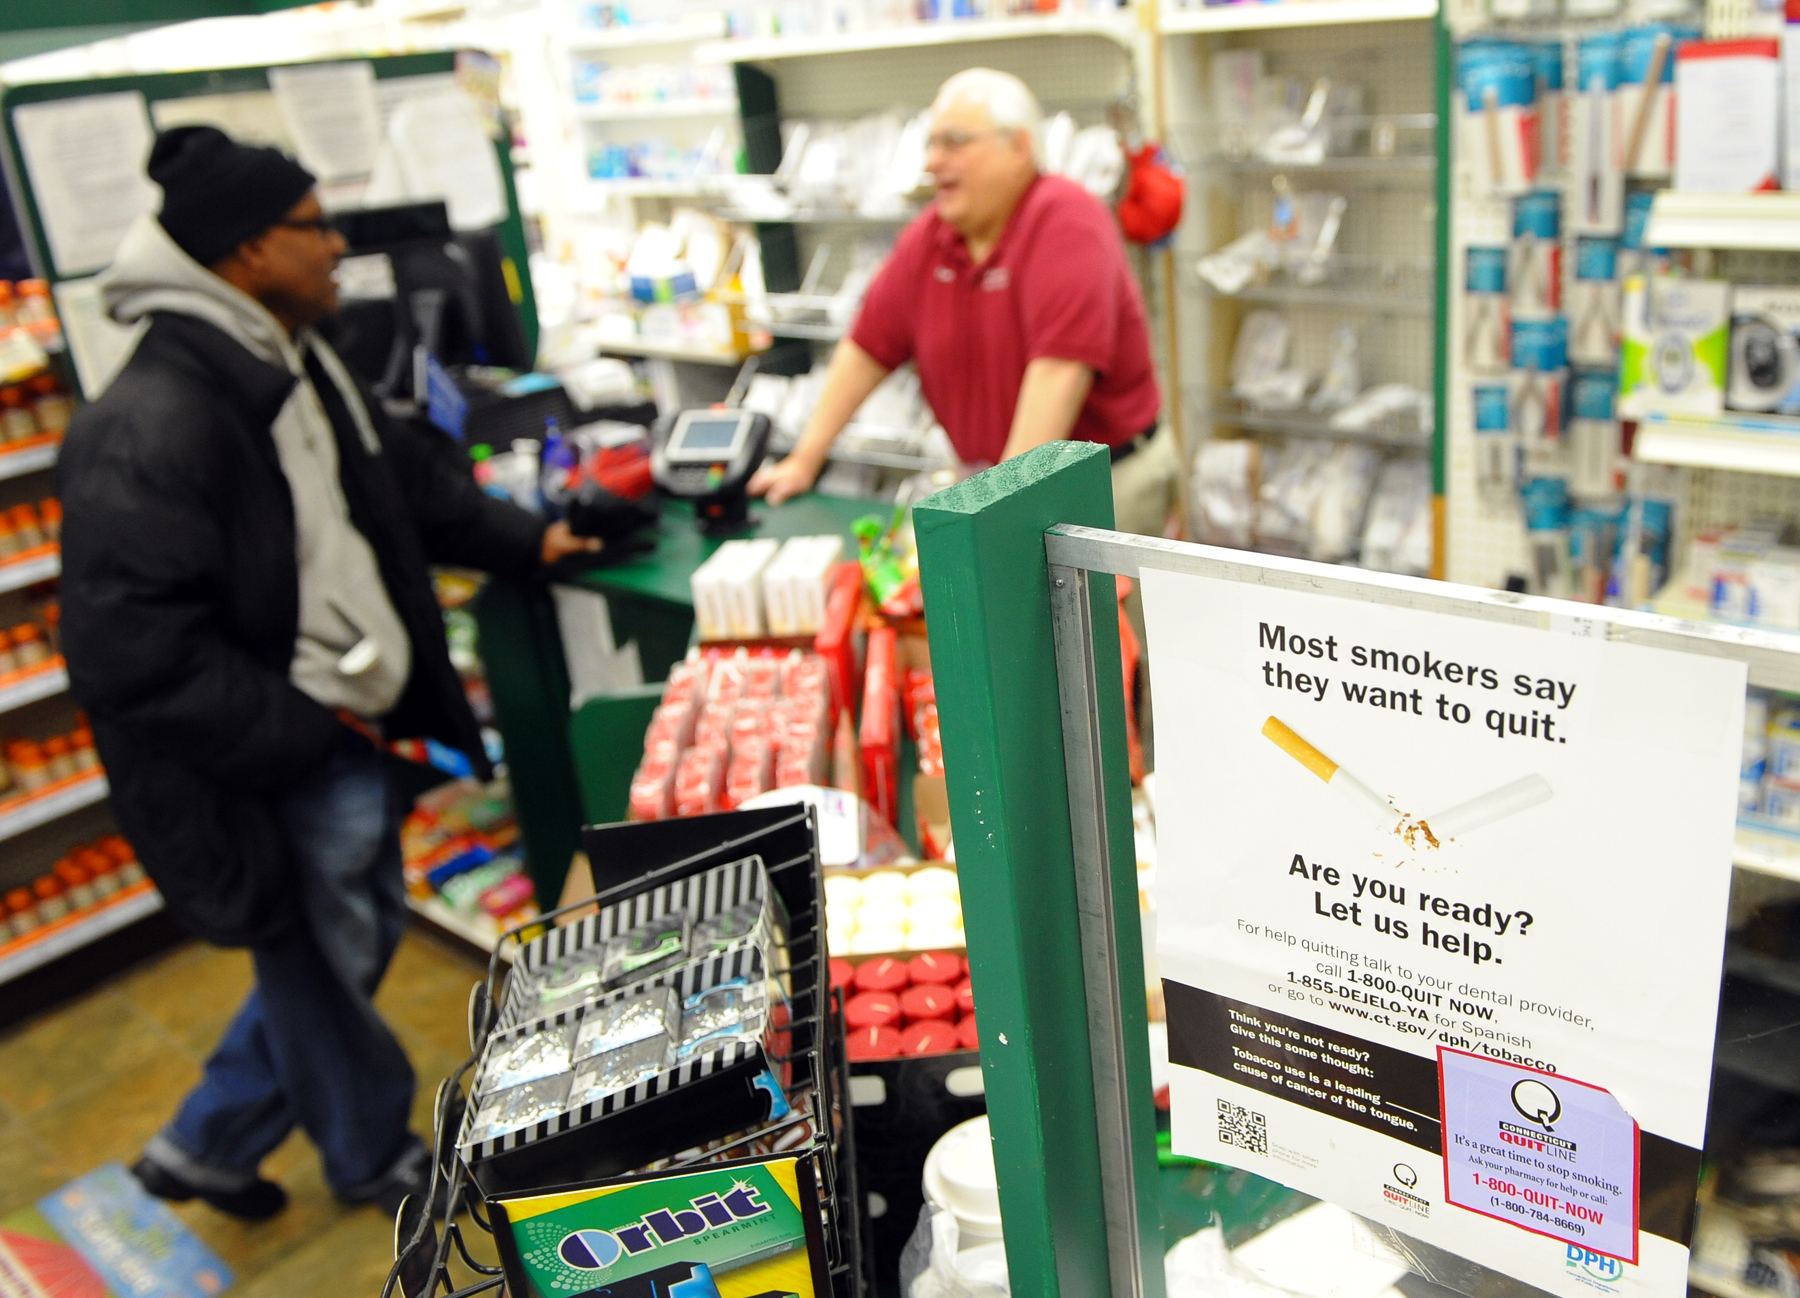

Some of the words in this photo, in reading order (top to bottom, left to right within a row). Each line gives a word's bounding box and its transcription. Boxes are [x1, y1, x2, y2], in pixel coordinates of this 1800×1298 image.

[1258, 621, 1338, 662] Most
[1350, 644, 1499, 690] smokers
[1513, 673, 1577, 710] say
[1262, 661, 1330, 701] they
[1341, 680, 1423, 716] want
[1436, 694, 1472, 724] to
[1485, 708, 1567, 744] quit.
[1288, 853, 1341, 887] Are
[1352, 873, 1406, 906] you
[1419, 892, 1534, 936] ready?
[1314, 891, 1362, 926] Let
[1374, 912, 1410, 940] us
[1422, 922, 1503, 965] help.
[1237, 919, 1260, 935] For
[1265, 926, 1297, 947] help
[1301, 938, 1359, 967] quitting
[1363, 955, 1393, 974] talk
[1397, 965, 1413, 980] to
[1417, 973, 1453, 991] your
[1458, 983, 1513, 1007] dental
[1519, 998, 1595, 1031] provider,
[1316, 962, 1342, 978] call
[1347, 969, 1443, 1007] 1-800-QUIT
[1449, 998, 1499, 1024] NOW,
[1228, 1009, 1262, 1029] Think
[1264, 1022, 1301, 1040] you're
[1303, 1033, 1325, 1048] not
[1328, 1042, 1370, 1062] ready?
[1268, 983, 1283, 994] or
[1287, 987, 1305, 1001] go
[1309, 993, 1324, 1006] to
[1328, 1001, 1557, 1073] www.ct.gov/dph/tobacco
[1287, 971, 1430, 1022] 1-855-DEJELO-YA
[1434, 1013, 1457, 1029] for
[1462, 1020, 1532, 1049] Spanish
[1229, 1023, 1256, 1040] Give
[1258, 1032, 1282, 1048] this
[1285, 1042, 1318, 1060] some
[1321, 1052, 1374, 1078] thought:
[1232, 1046, 1282, 1070] Tobacco
[1284, 1064, 1306, 1078] use
[1309, 1071, 1320, 1084] is
[1323, 1078, 1332, 1088] a
[1334, 1080, 1382, 1106] leading
[1233, 1062, 1268, 1080] cause
[1271, 1075, 1284, 1085] of
[1286, 1080, 1328, 1100] cancer
[1330, 1094, 1344, 1106] of
[1346, 1098, 1367, 1113] the
[1370, 1106, 1419, 1132] tongue.
[1454, 1133, 1470, 1147] It's
[1472, 1140, 1478, 1149] a
[1479, 1143, 1506, 1158] great
[1508, 1150, 1532, 1166] time
[1534, 1159, 1545, 1170] to
[1547, 1162, 1570, 1179] stop
[1572, 1171, 1623, 1196] smoking.
[1501, 1121, 1574, 1150] CONNECTICUT
[1468, 1154, 1483, 1165] Ask
[1484, 1159, 1503, 1173] your
[1504, 1166, 1545, 1186] pharmacy
[1546, 1178, 1559, 1189] for
[1560, 1183, 1579, 1197] help
[1579, 1191, 1590, 1199] or
[1591, 1194, 1608, 1205] call:
[1472, 1172, 1604, 1225] 1-800-QUIT-NOW
[557, 1186, 773, 1271] Orbit
[693, 1213, 777, 1246] SPEARMINT
[1490, 1196, 1585, 1236] (1-800-784-8669)
[1566, 1244, 1615, 1274] DPH
